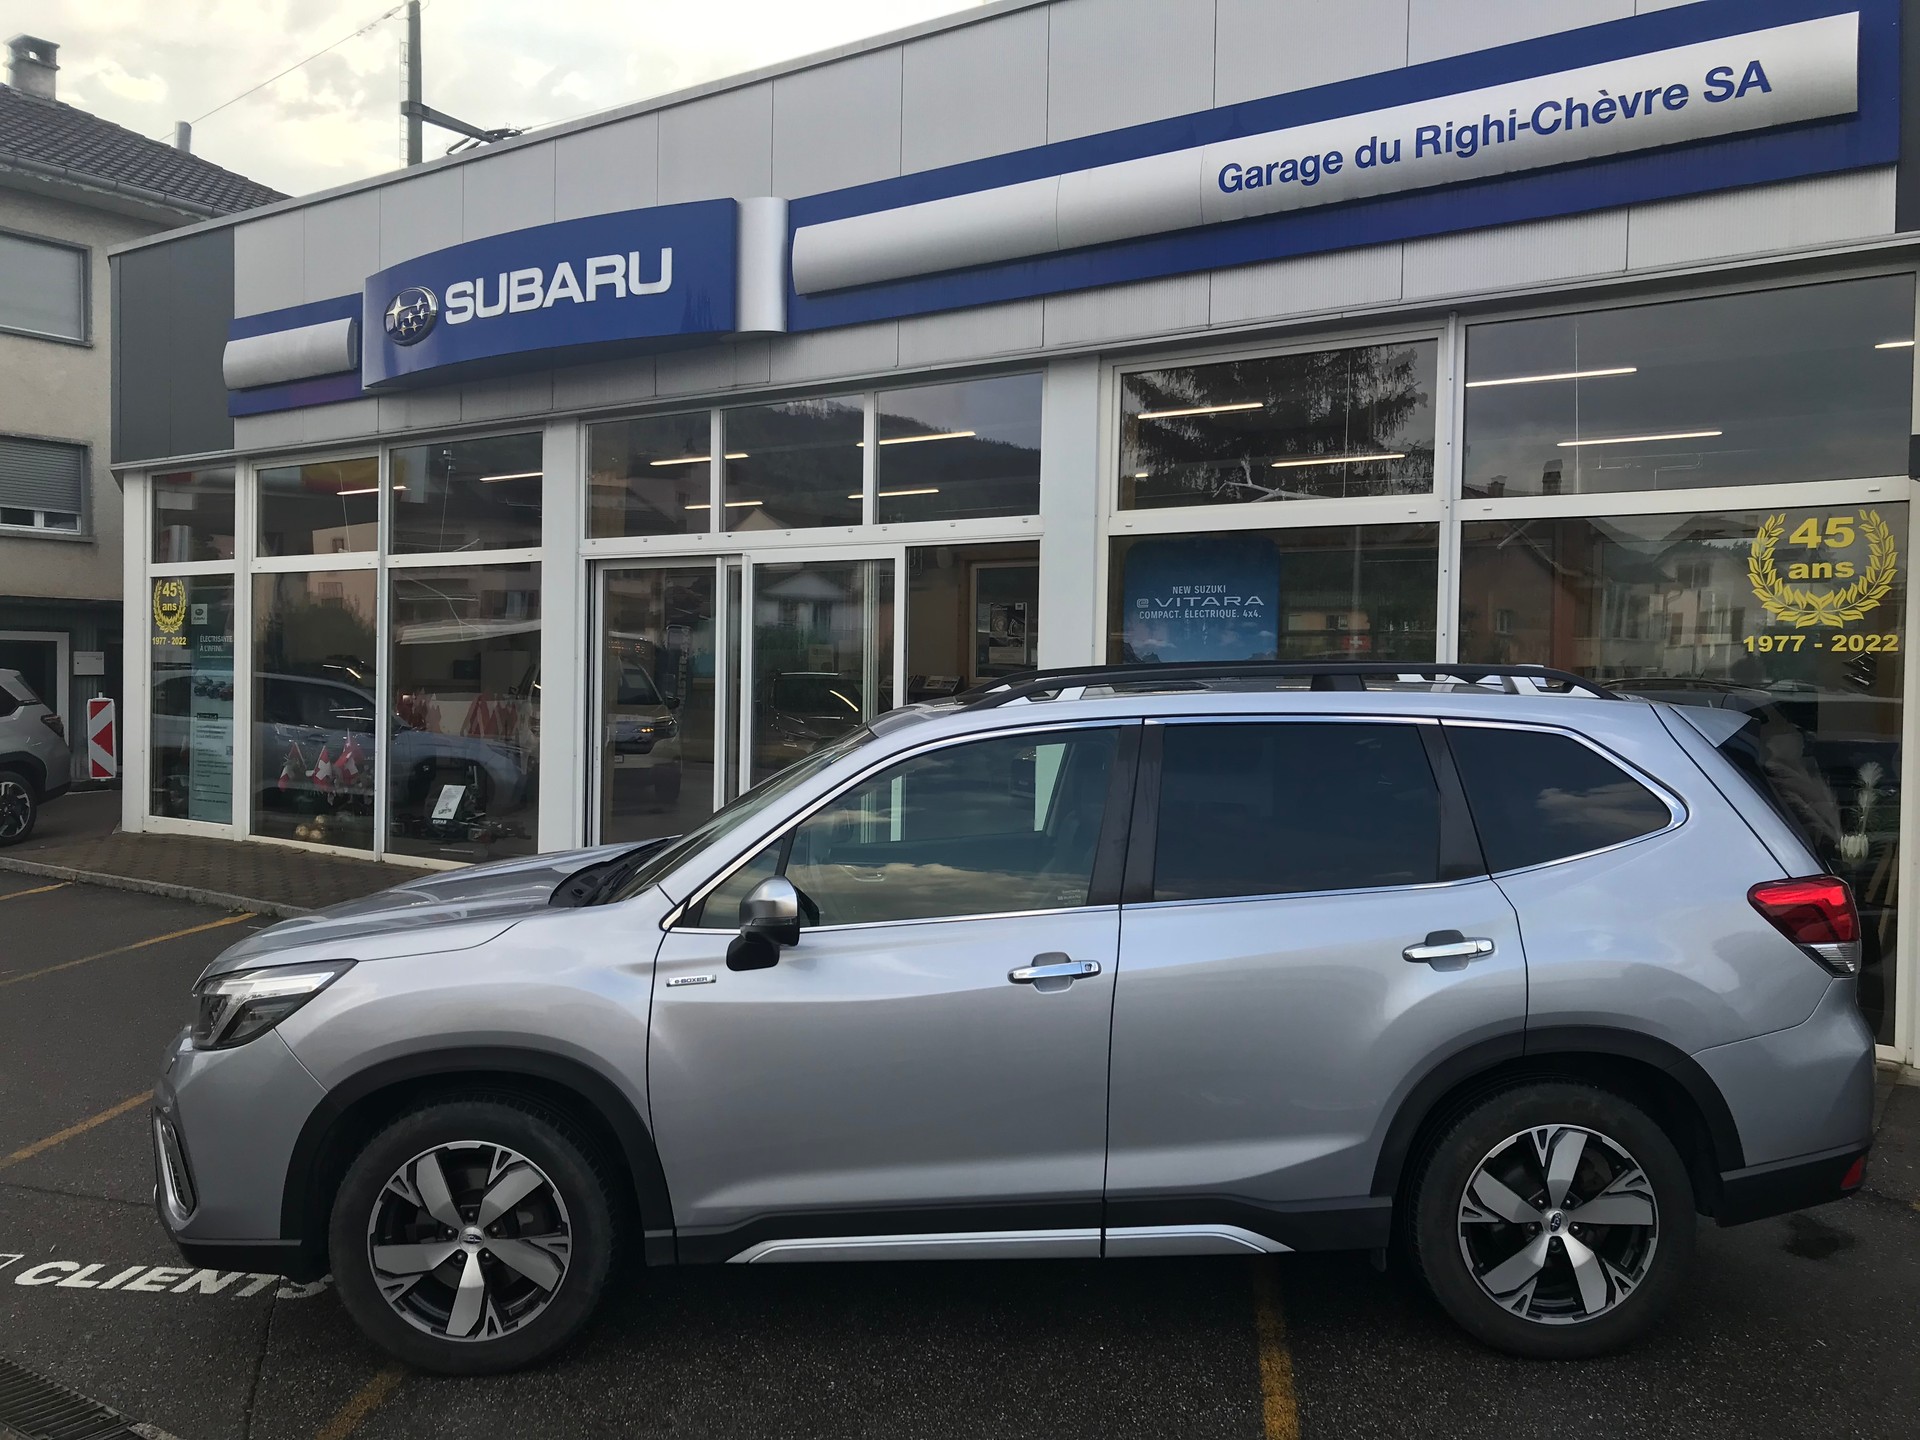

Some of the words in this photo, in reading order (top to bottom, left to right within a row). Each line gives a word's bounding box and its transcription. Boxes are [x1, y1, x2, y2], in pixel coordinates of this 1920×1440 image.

[1217, 150, 1344, 194] Garage
[1354, 135, 1401, 169] du
[1414, 83, 1690, 159] Righi-Chèvre
[1703, 59, 1773, 103] SA
[444, 246, 673, 326] SUBARU
[1788, 516, 1856, 550] 45
[1787, 560, 1856, 580] ans
[162, 582, 178, 597] 45
[1172, 585, 1192, 595] NEW
[1194, 584, 1227, 594] SUZUKI
[162, 602, 178, 612] ans
[1154, 595, 1265, 608] VITARA
[1139, 610, 1182, 619] COMPACT.
[1184, 608, 1240, 619] ÉLECTRIQUE.
[152, 636, 167, 646] 1977
[171, 636, 187, 646] 2022
[1743, 634, 1806, 653] 1977
[1830, 634, 1899, 653] 2022
